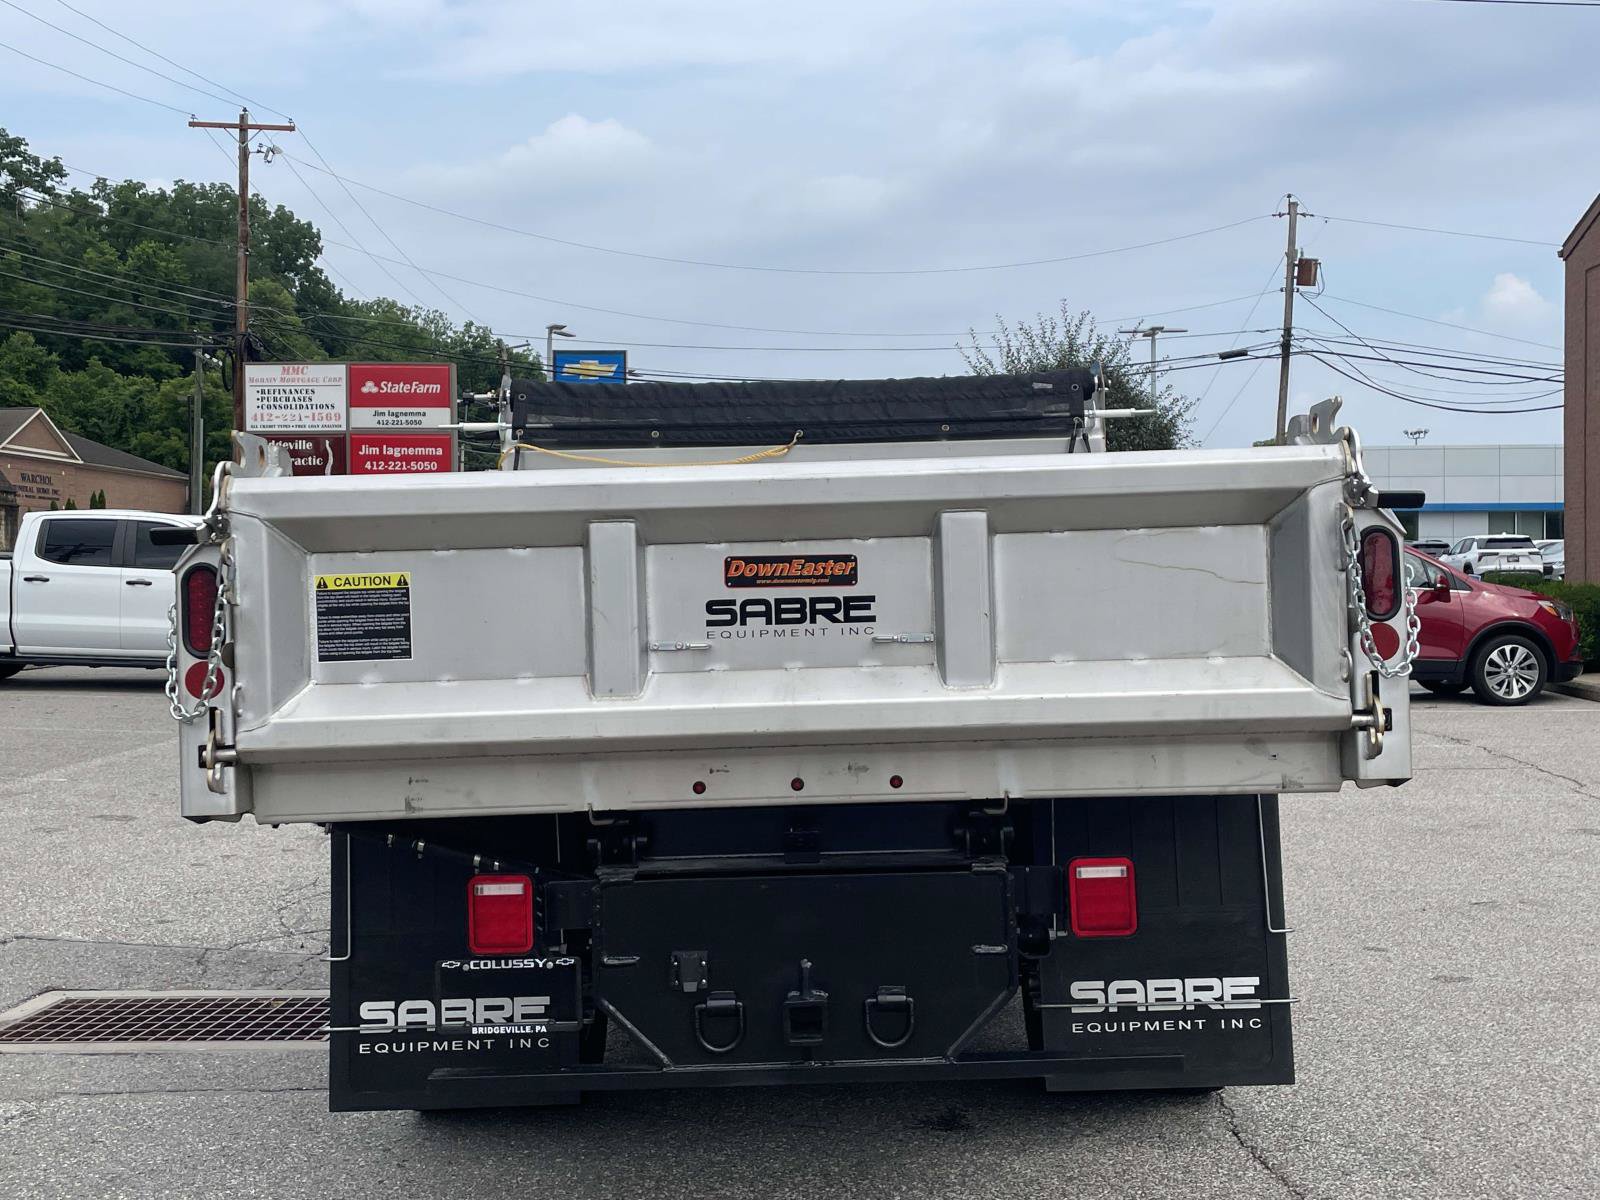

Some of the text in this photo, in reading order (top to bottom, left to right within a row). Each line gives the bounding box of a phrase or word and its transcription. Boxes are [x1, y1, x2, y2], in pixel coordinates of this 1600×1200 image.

[280, 365, 309, 375] MMC
[380, 381, 441, 394] StateFarm
[251, 412, 342, 422] 412-221-1569
[387, 410, 427, 418] Iagnemma
[359, 444, 443, 457] Jim Iagnemma
[364, 460, 438, 471] 412-221-5050
[727, 558, 856, 578] DownEaster
[333, 575, 391, 588] CAUTION
[705, 595, 877, 627] SABRE
[706, 626, 875, 640] EQUIPMENT INC
[469, 958, 547, 970] COLUSSY
[1070, 976, 1262, 1014] SABRE
[359, 995, 551, 1034] SABRE
[535, 1025, 548, 1034] PA
[1071, 1018, 1263, 1034] EQUIPMENT INC
[359, 1037, 550, 1054] EQUIPMENT INC
